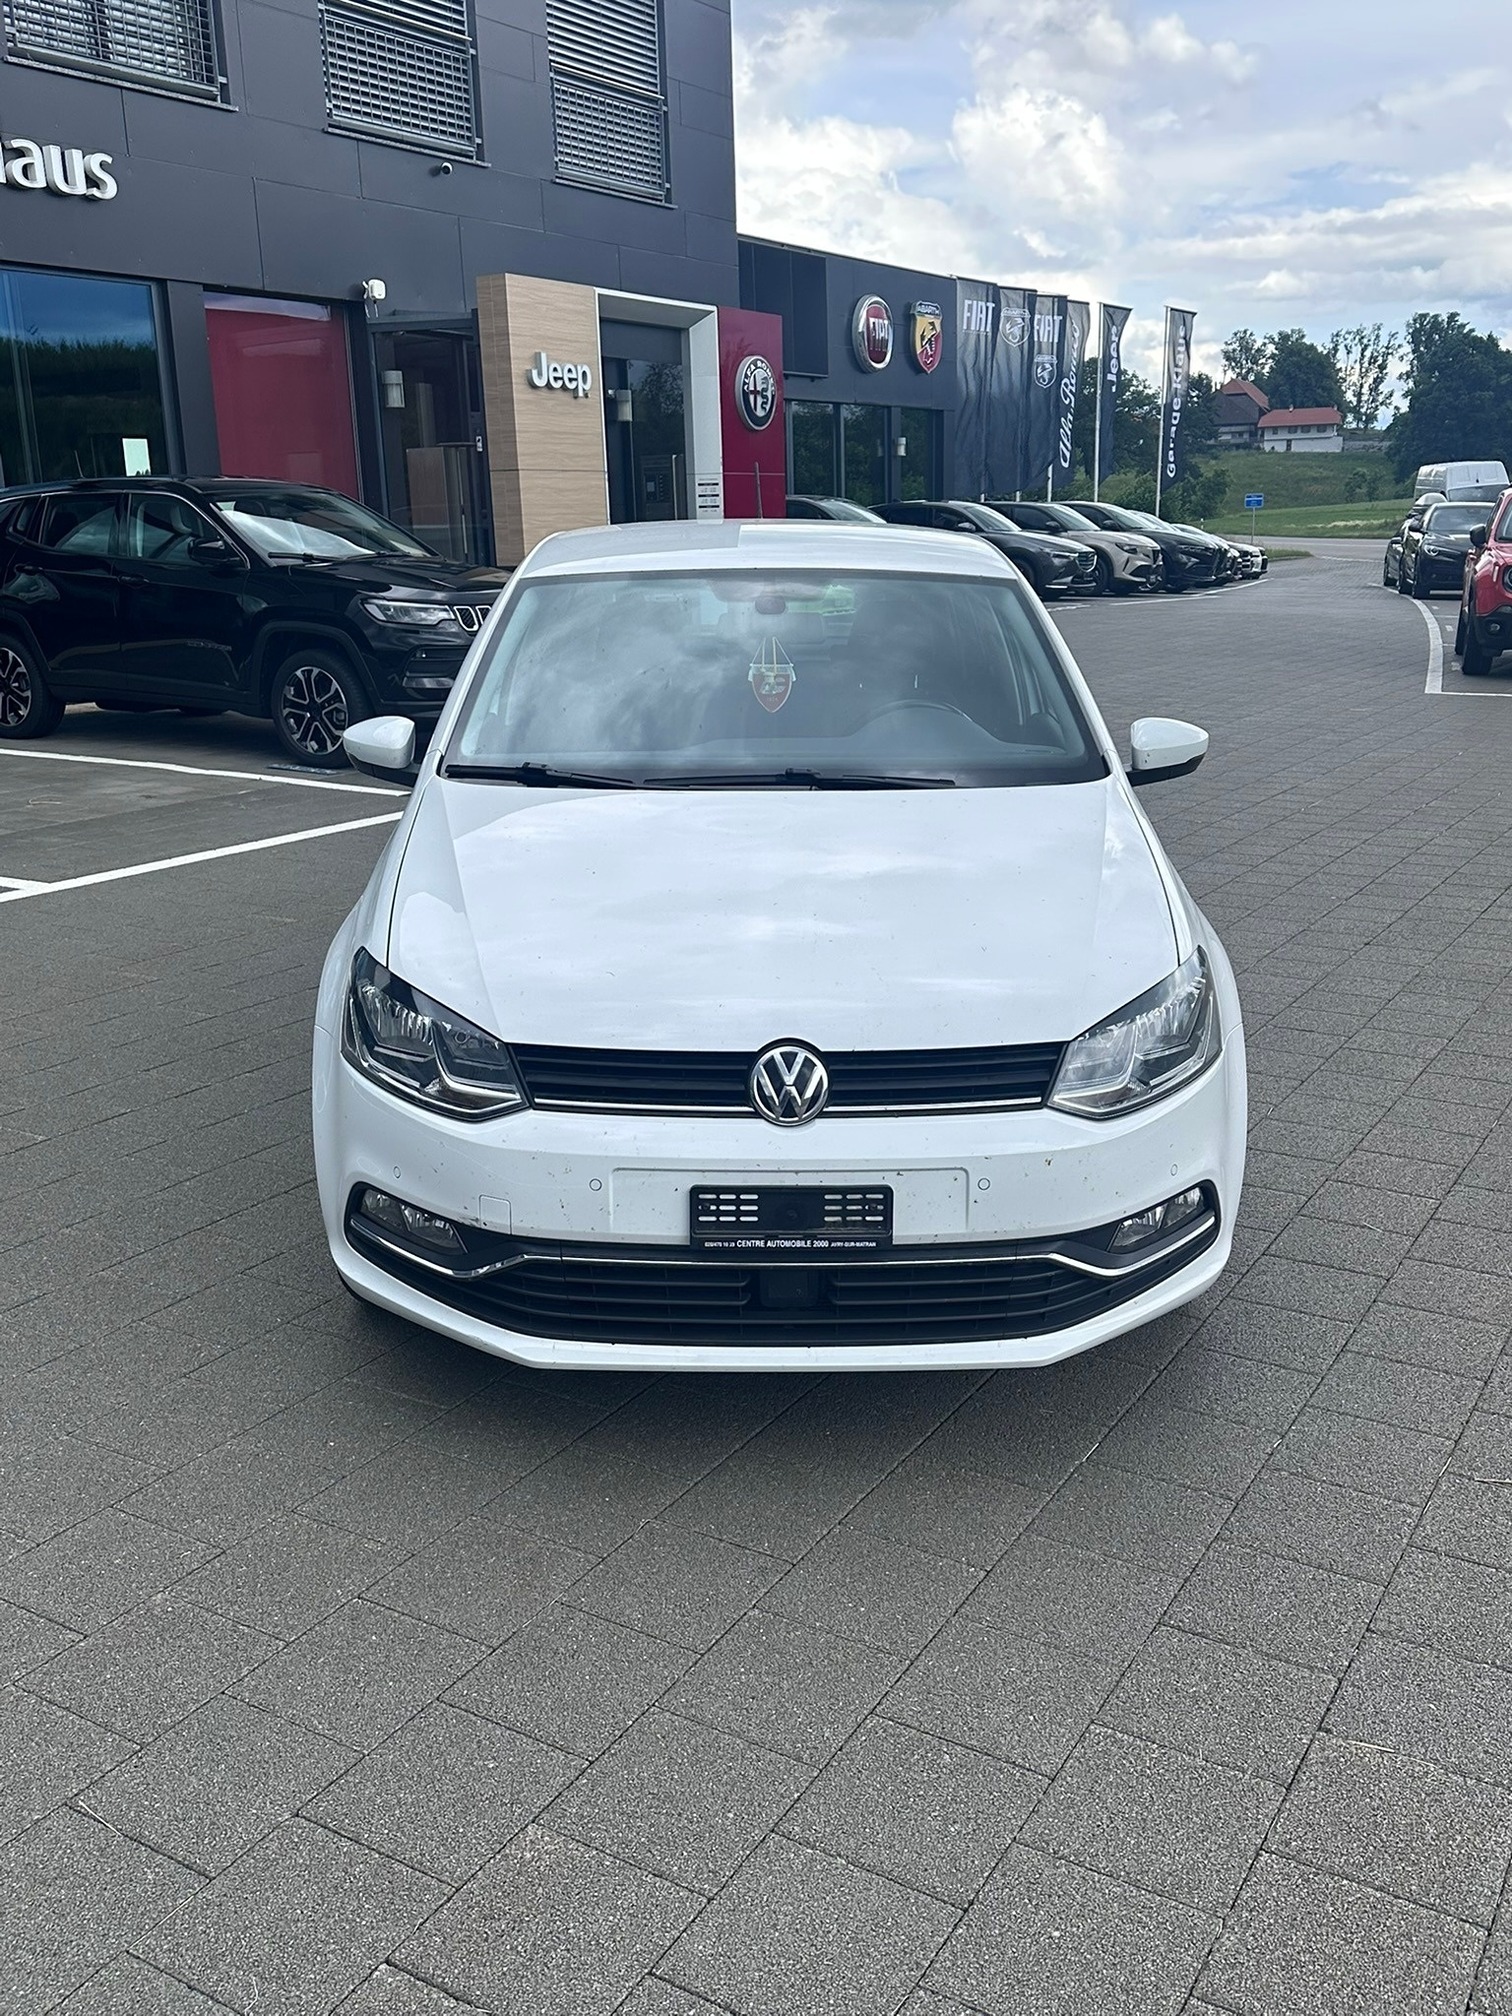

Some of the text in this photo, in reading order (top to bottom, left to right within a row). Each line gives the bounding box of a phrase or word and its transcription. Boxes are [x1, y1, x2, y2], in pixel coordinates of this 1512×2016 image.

[963, 299, 996, 332] FIAT
[1034, 314, 1063, 343] FIAT
[527, 351, 592, 398] Jeep
[1166, 325, 1186, 478] Garage Klaus
[736, 1239, 765, 1248] CENTRE
[766, 1239, 812, 1248] AUTOMOBILE
[812, 1239, 830, 1248] 2000
